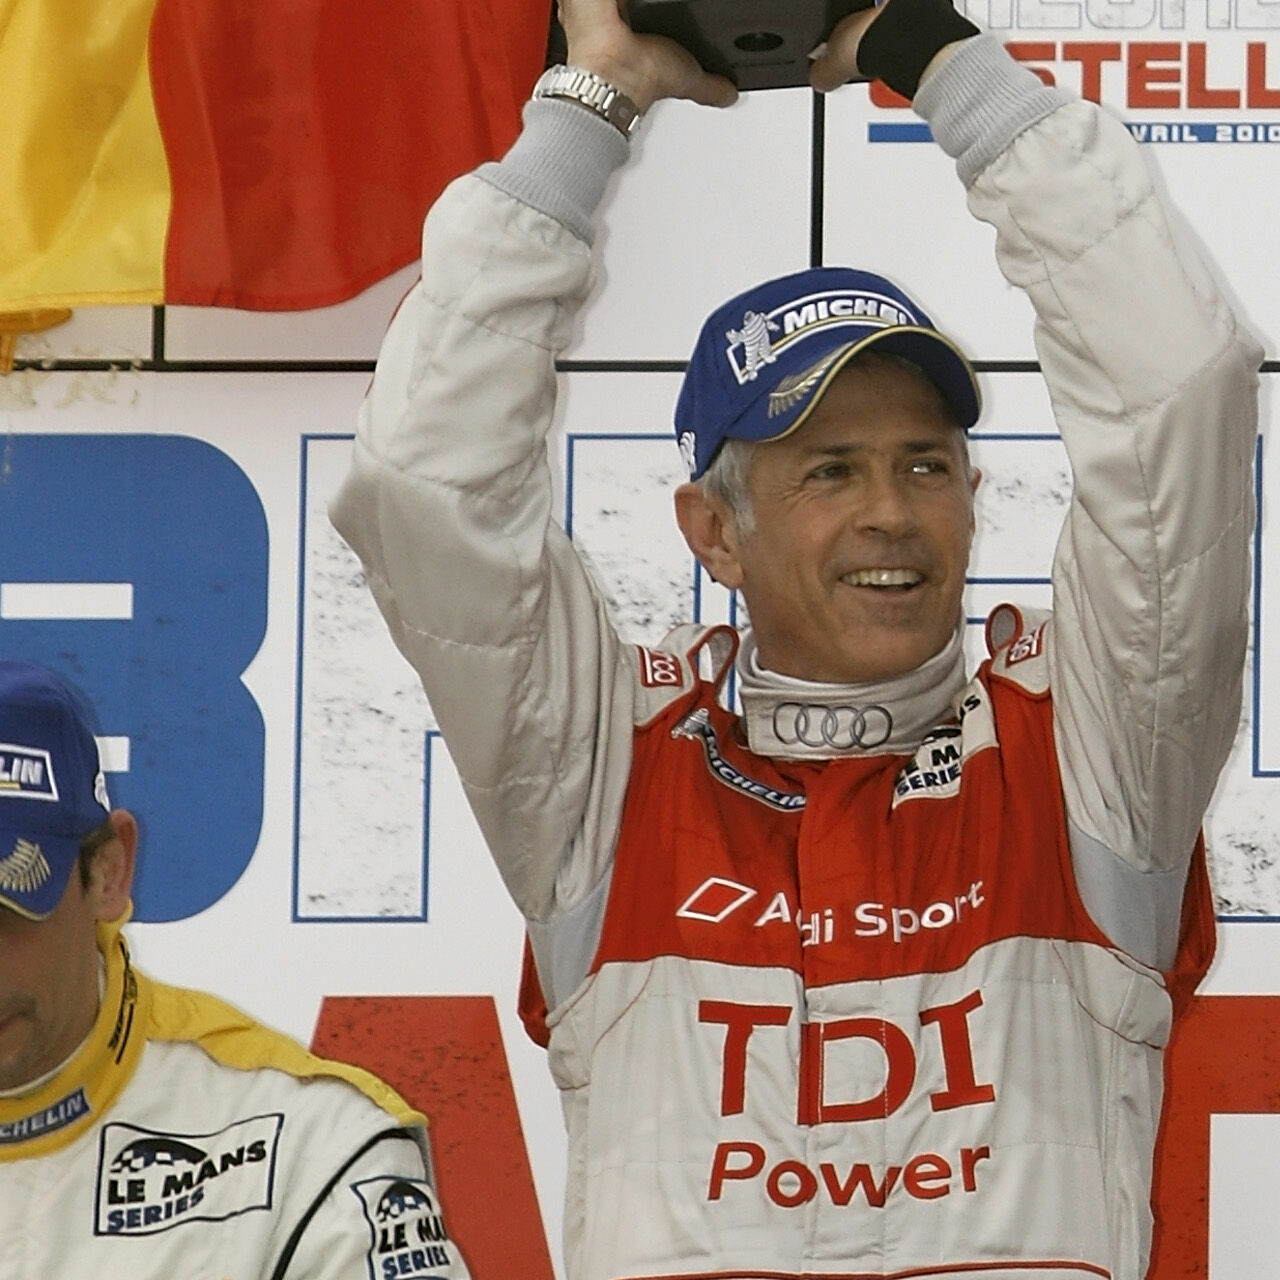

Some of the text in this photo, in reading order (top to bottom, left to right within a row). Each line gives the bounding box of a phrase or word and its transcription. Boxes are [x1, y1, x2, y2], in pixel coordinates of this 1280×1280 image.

[1131, 124, 1199, 142] VRIL
[783, 298, 907, 335] MICHE
[896, 763, 962, 797] SERIE
[854, 880, 986, 943] Sport
[698, 989, 996, 1127] TDI
[0, 1093, 84, 1138] CHELIN
[108, 1139, 267, 1205] LE MANS
[707, 1141, 991, 1208] Power
[107, 1186, 205, 1232] SERIES
[379, 1222, 409, 1254] LE
